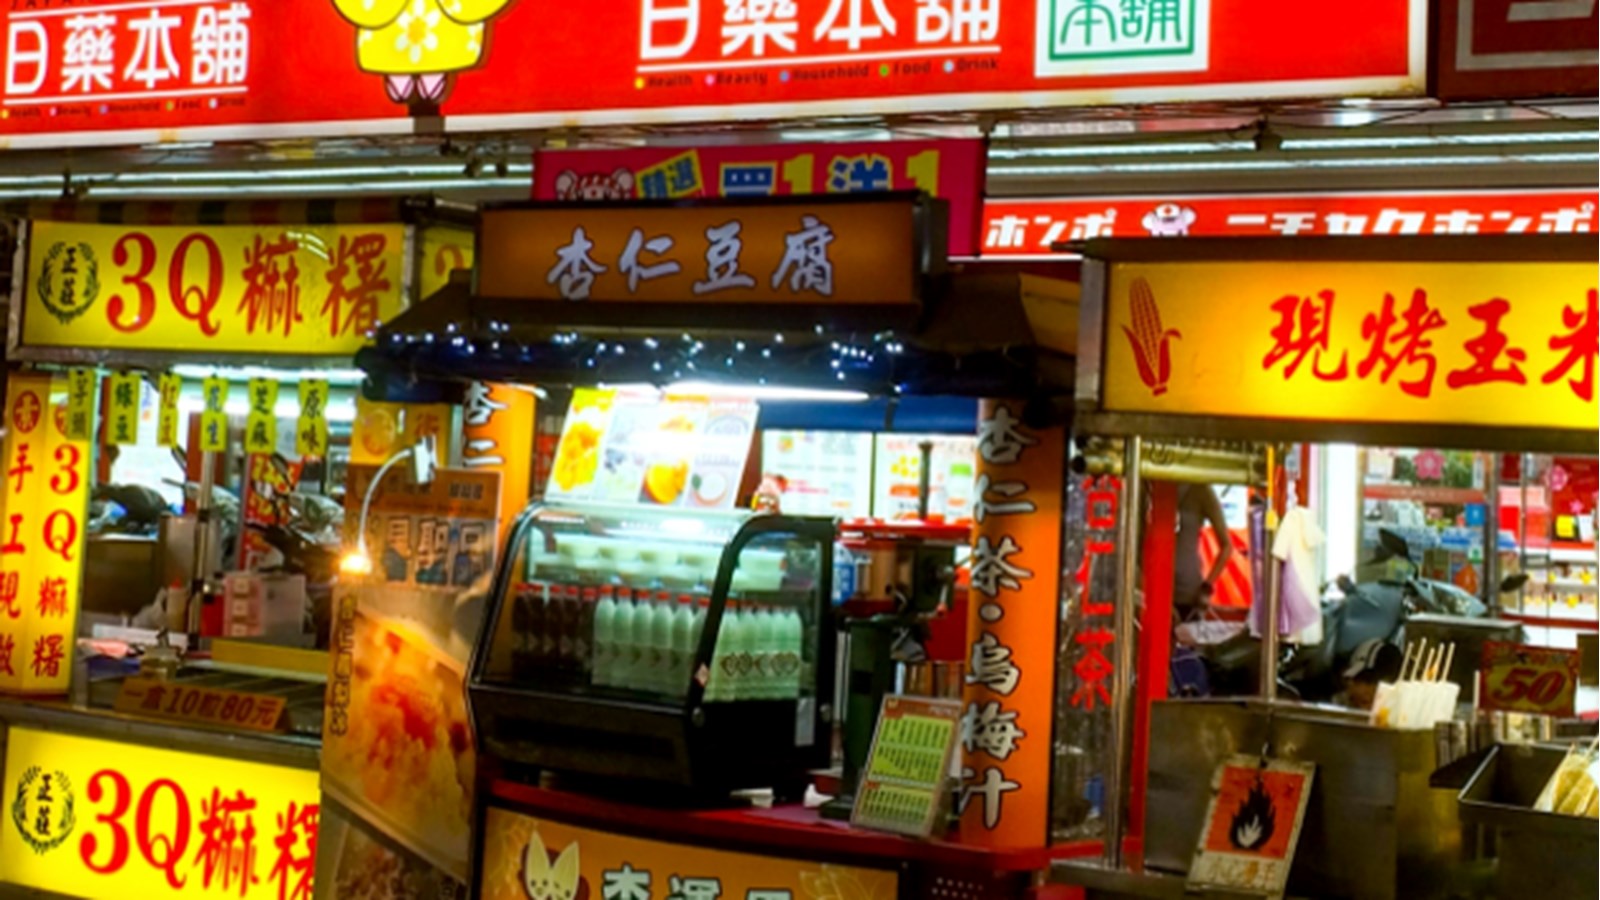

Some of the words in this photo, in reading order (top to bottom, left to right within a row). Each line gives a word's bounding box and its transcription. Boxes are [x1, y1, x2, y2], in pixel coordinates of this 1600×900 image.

[4, 3, 250, 95] 日藥本舖
[546, 216, 836, 299] 杏仁豆腐
[1492, 667, 1567, 705] 50
